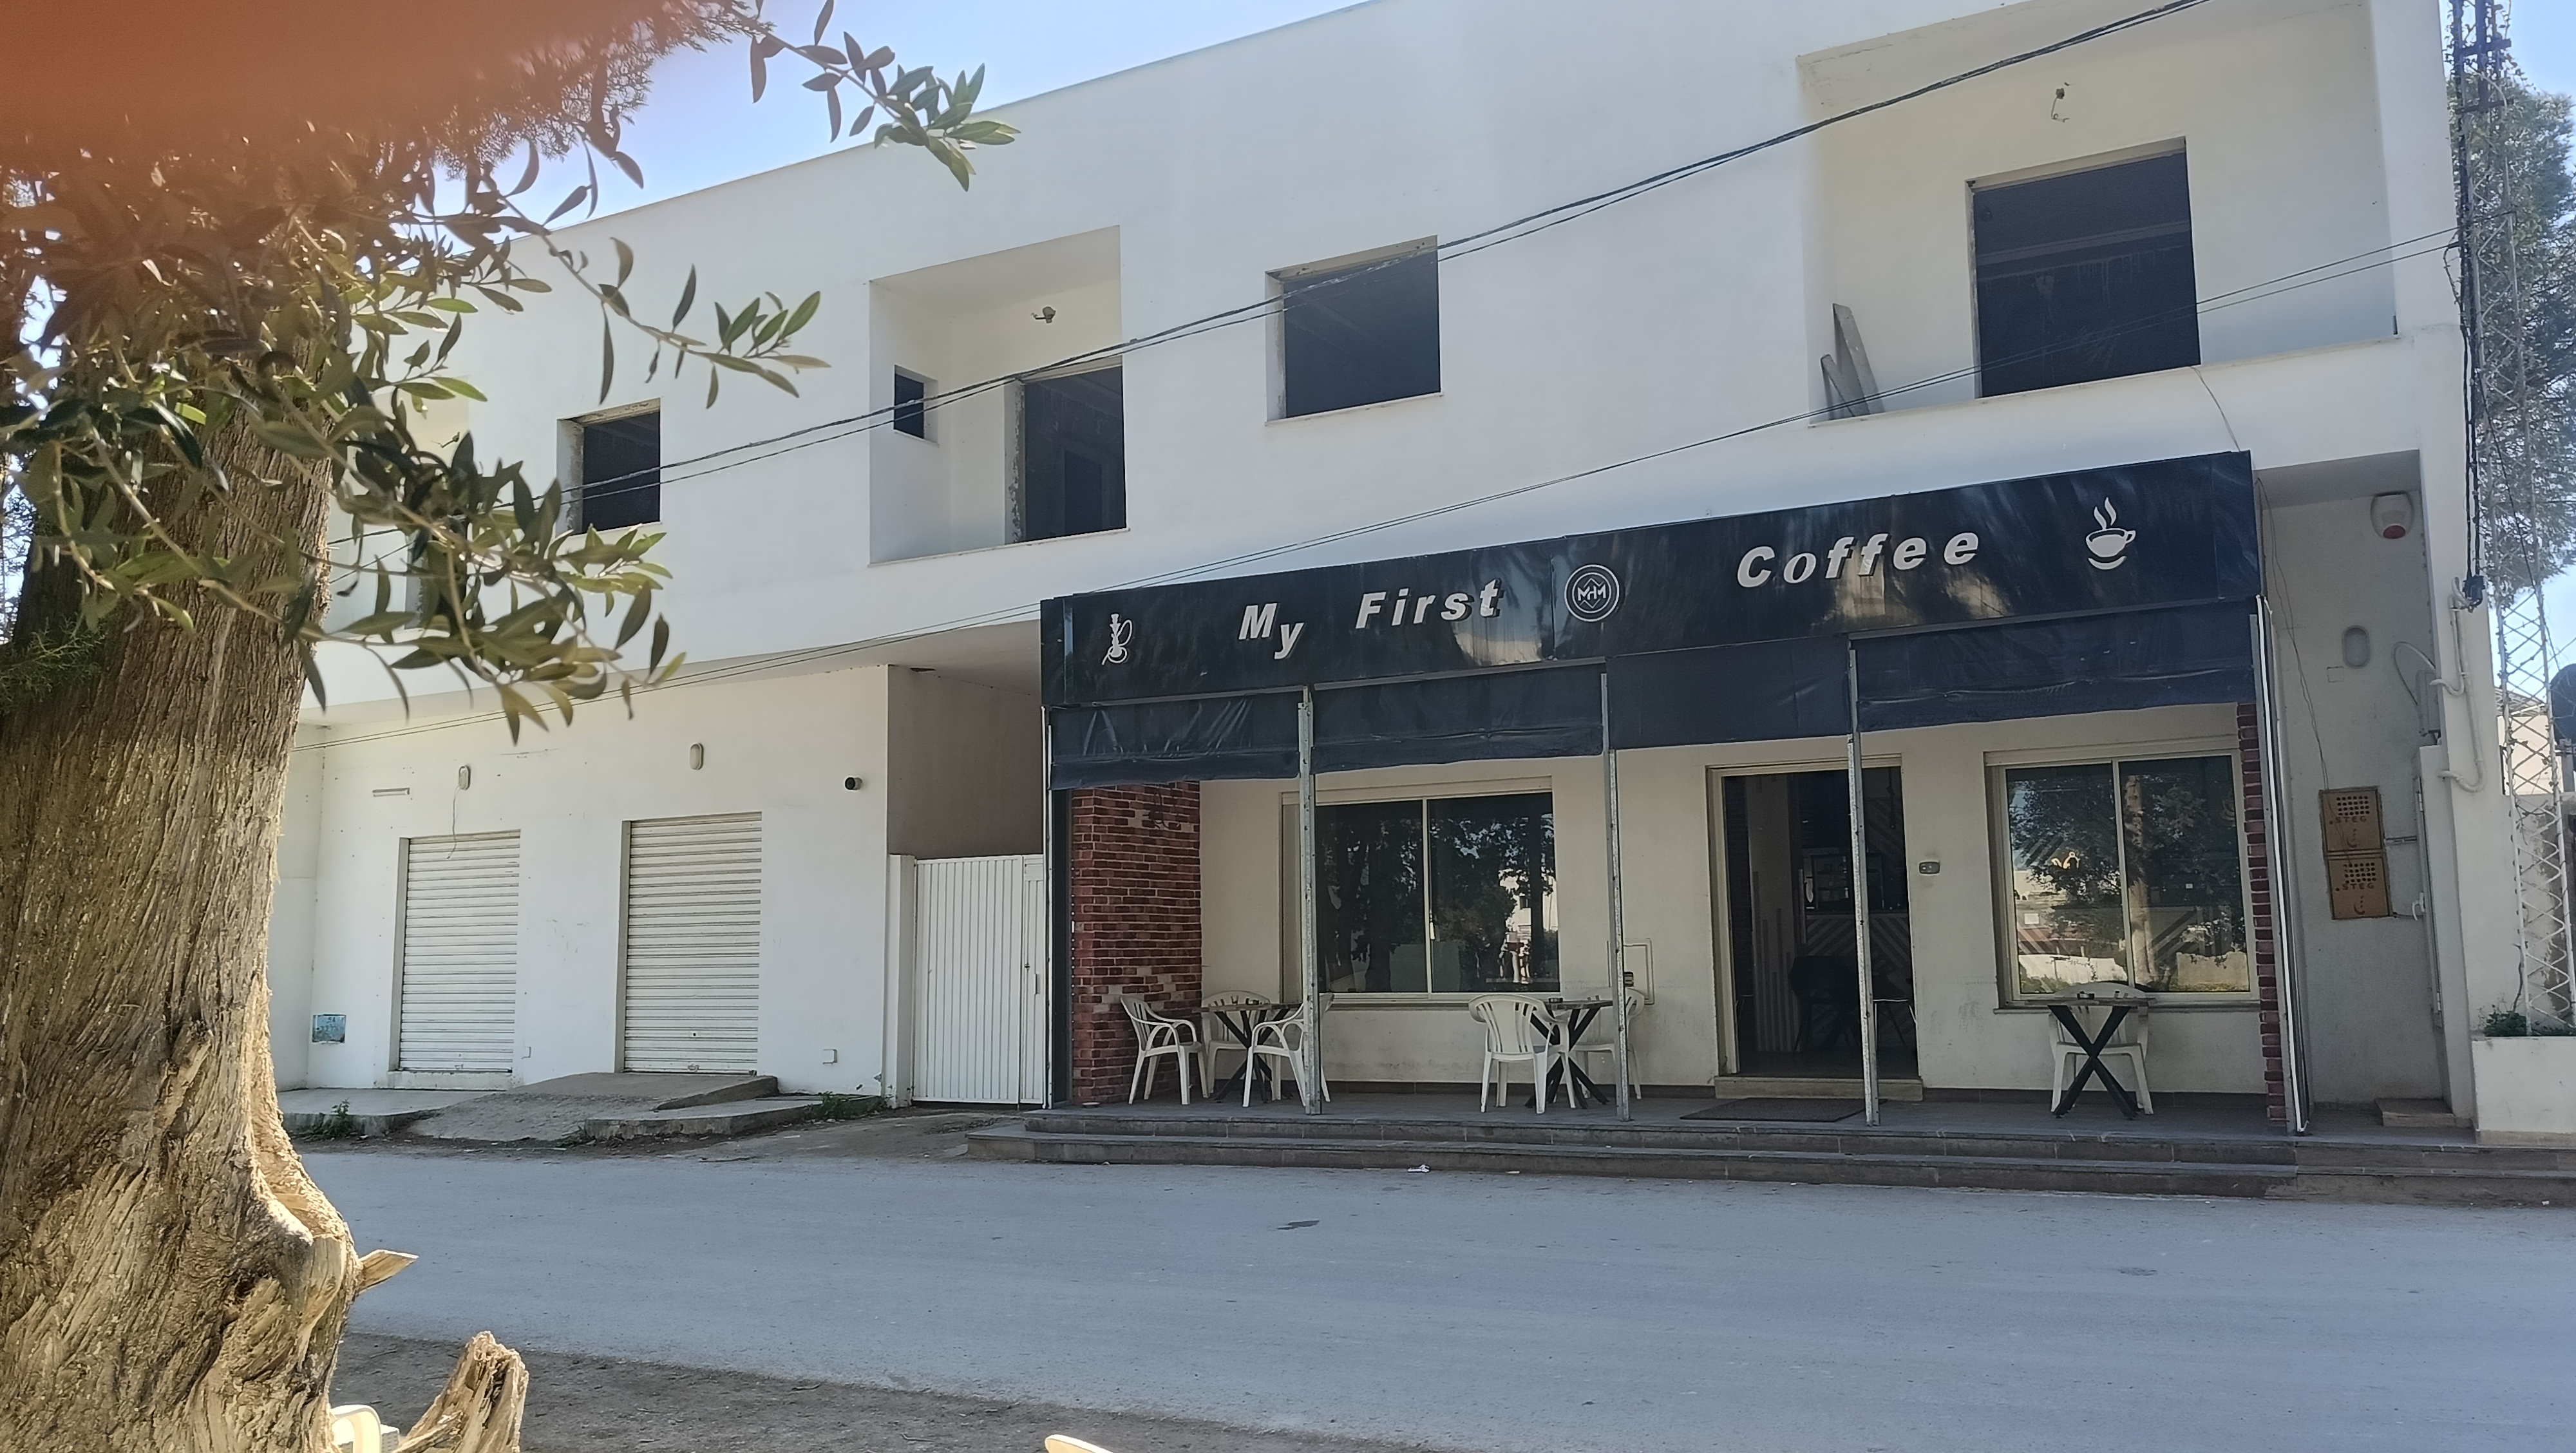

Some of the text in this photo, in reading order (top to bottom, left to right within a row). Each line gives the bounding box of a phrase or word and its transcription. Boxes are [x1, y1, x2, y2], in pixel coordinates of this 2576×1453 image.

[1239, 532, 1980, 659] My First Coffee
